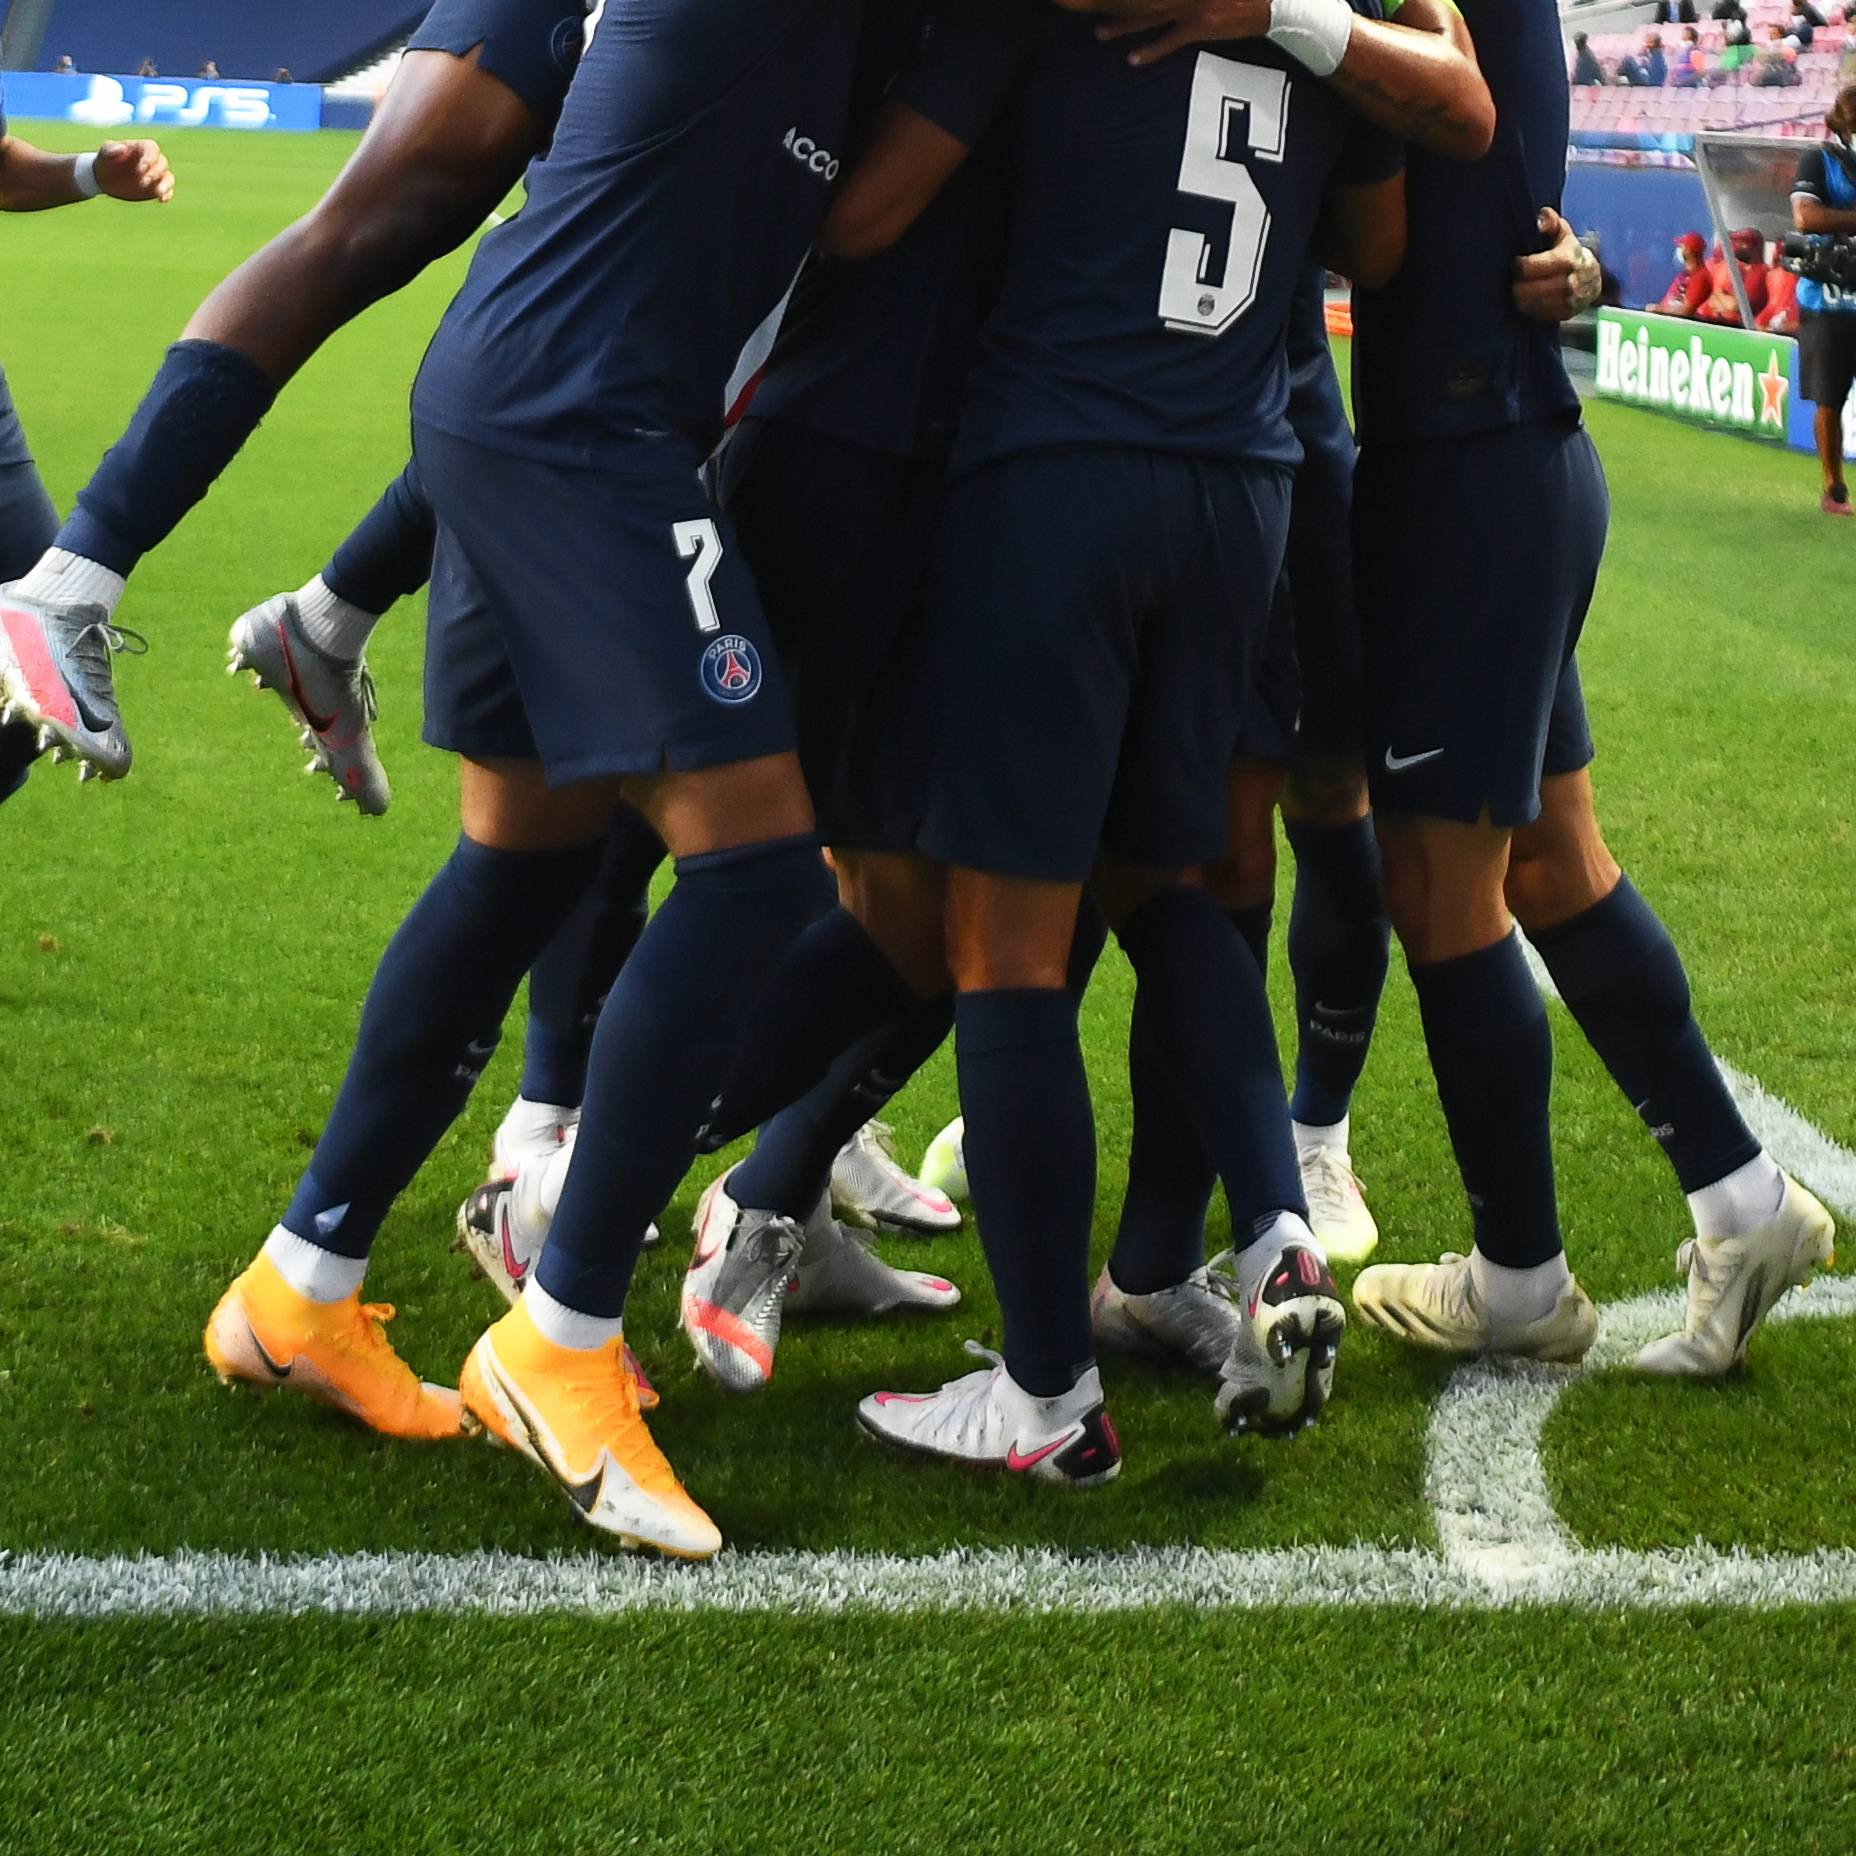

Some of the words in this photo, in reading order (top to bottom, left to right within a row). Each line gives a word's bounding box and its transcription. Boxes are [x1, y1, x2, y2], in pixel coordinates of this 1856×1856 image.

[137, 82, 270, 128] PS5
[782, 126, 840, 181] ACCO
[1158, 50, 1292, 336] 5
[1596, 319, 1755, 422] Heineken
[672, 518, 724, 632] 7
[708, 637, 747, 660] PARIS
